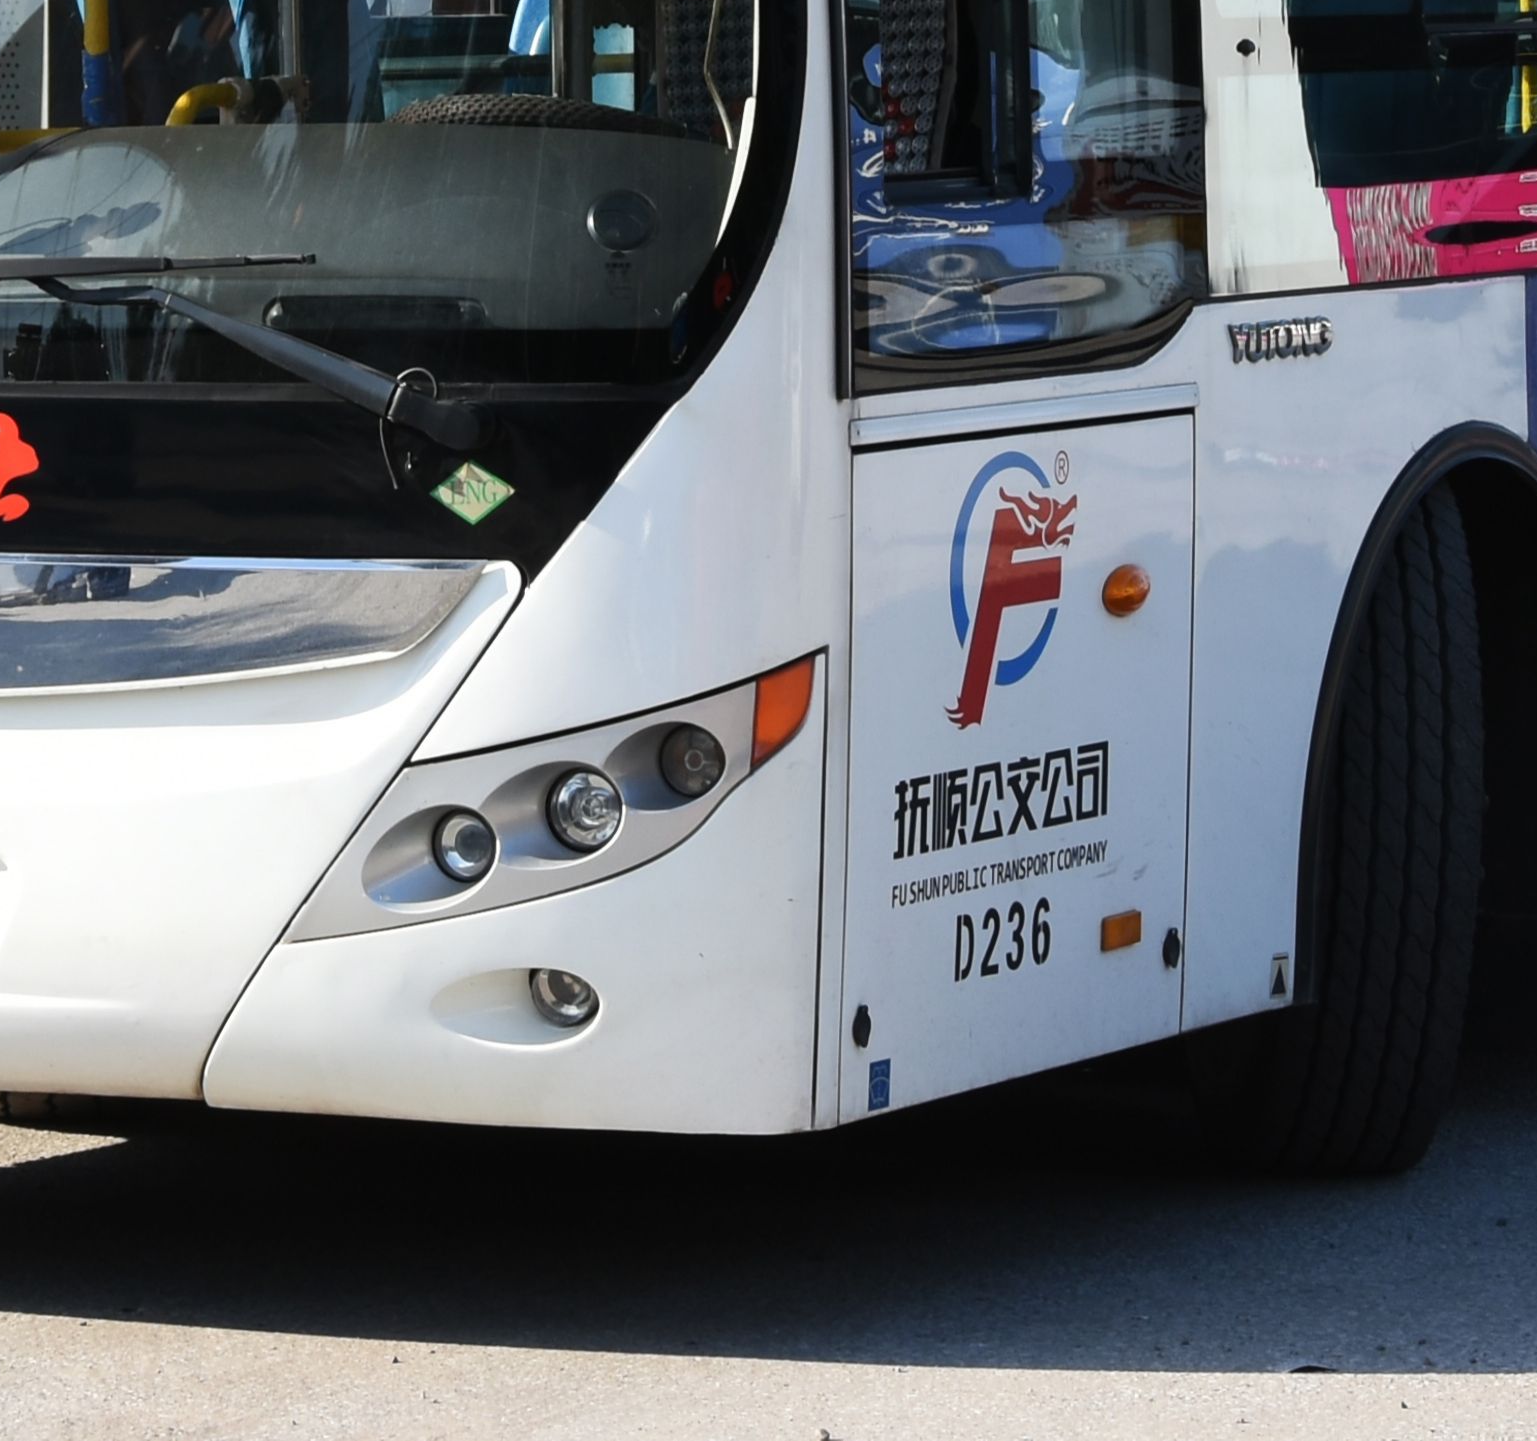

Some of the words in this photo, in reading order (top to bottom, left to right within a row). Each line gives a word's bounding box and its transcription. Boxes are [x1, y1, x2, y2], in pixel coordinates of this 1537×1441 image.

[1227, 315, 1333, 364] YUTONG
[893, 740, 1109, 860] 抚顺公交公司
[891, 884, 907, 908] FU
[909, 876, 940, 904] SHUN
[942, 865, 987, 896] PUBLIC
[990, 851, 1055, 885] TRANSPORT
[1057, 840, 1108, 871] COMPANY
[954, 897, 1051, 982] D236
